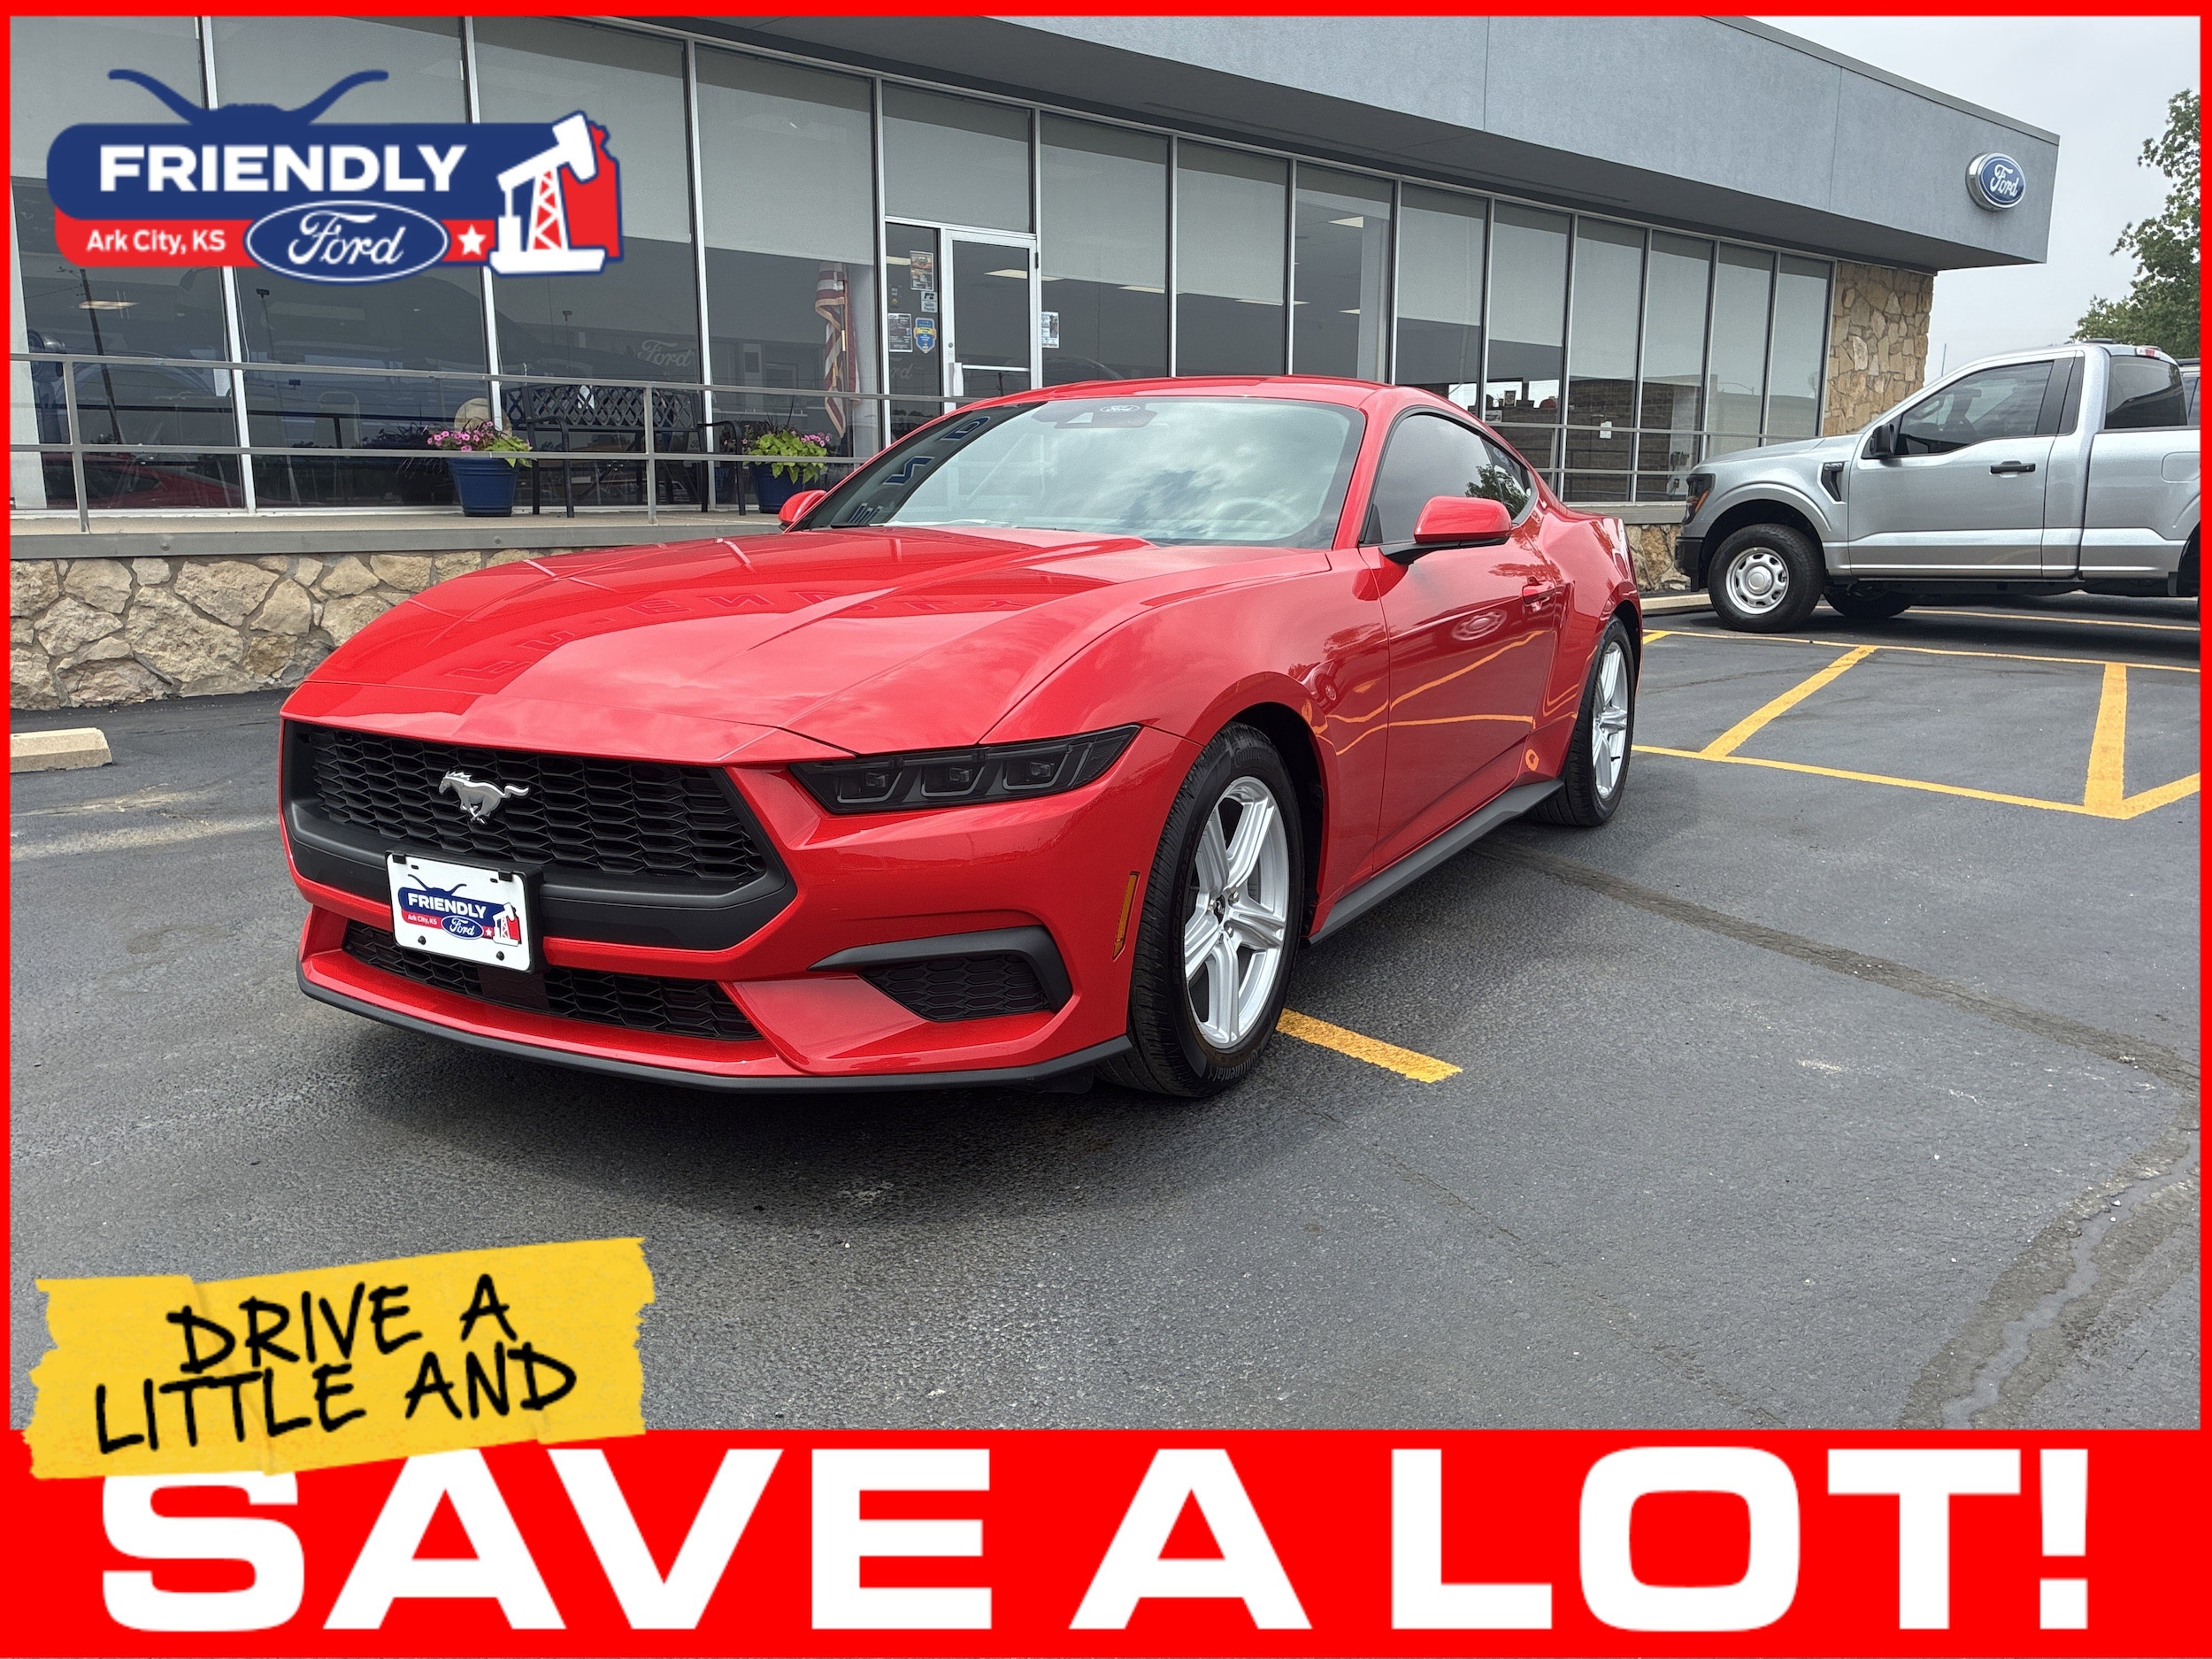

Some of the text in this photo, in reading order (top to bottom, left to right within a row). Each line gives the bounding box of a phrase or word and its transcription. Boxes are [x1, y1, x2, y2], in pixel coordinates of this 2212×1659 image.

[1990, 164, 2019, 197] Ford
[638, 340, 695, 367] Ford
[407, 892, 487, 919] FRIENDLY
[407, 913, 417, 922] Ark
[449, 918, 475, 936] Ford
